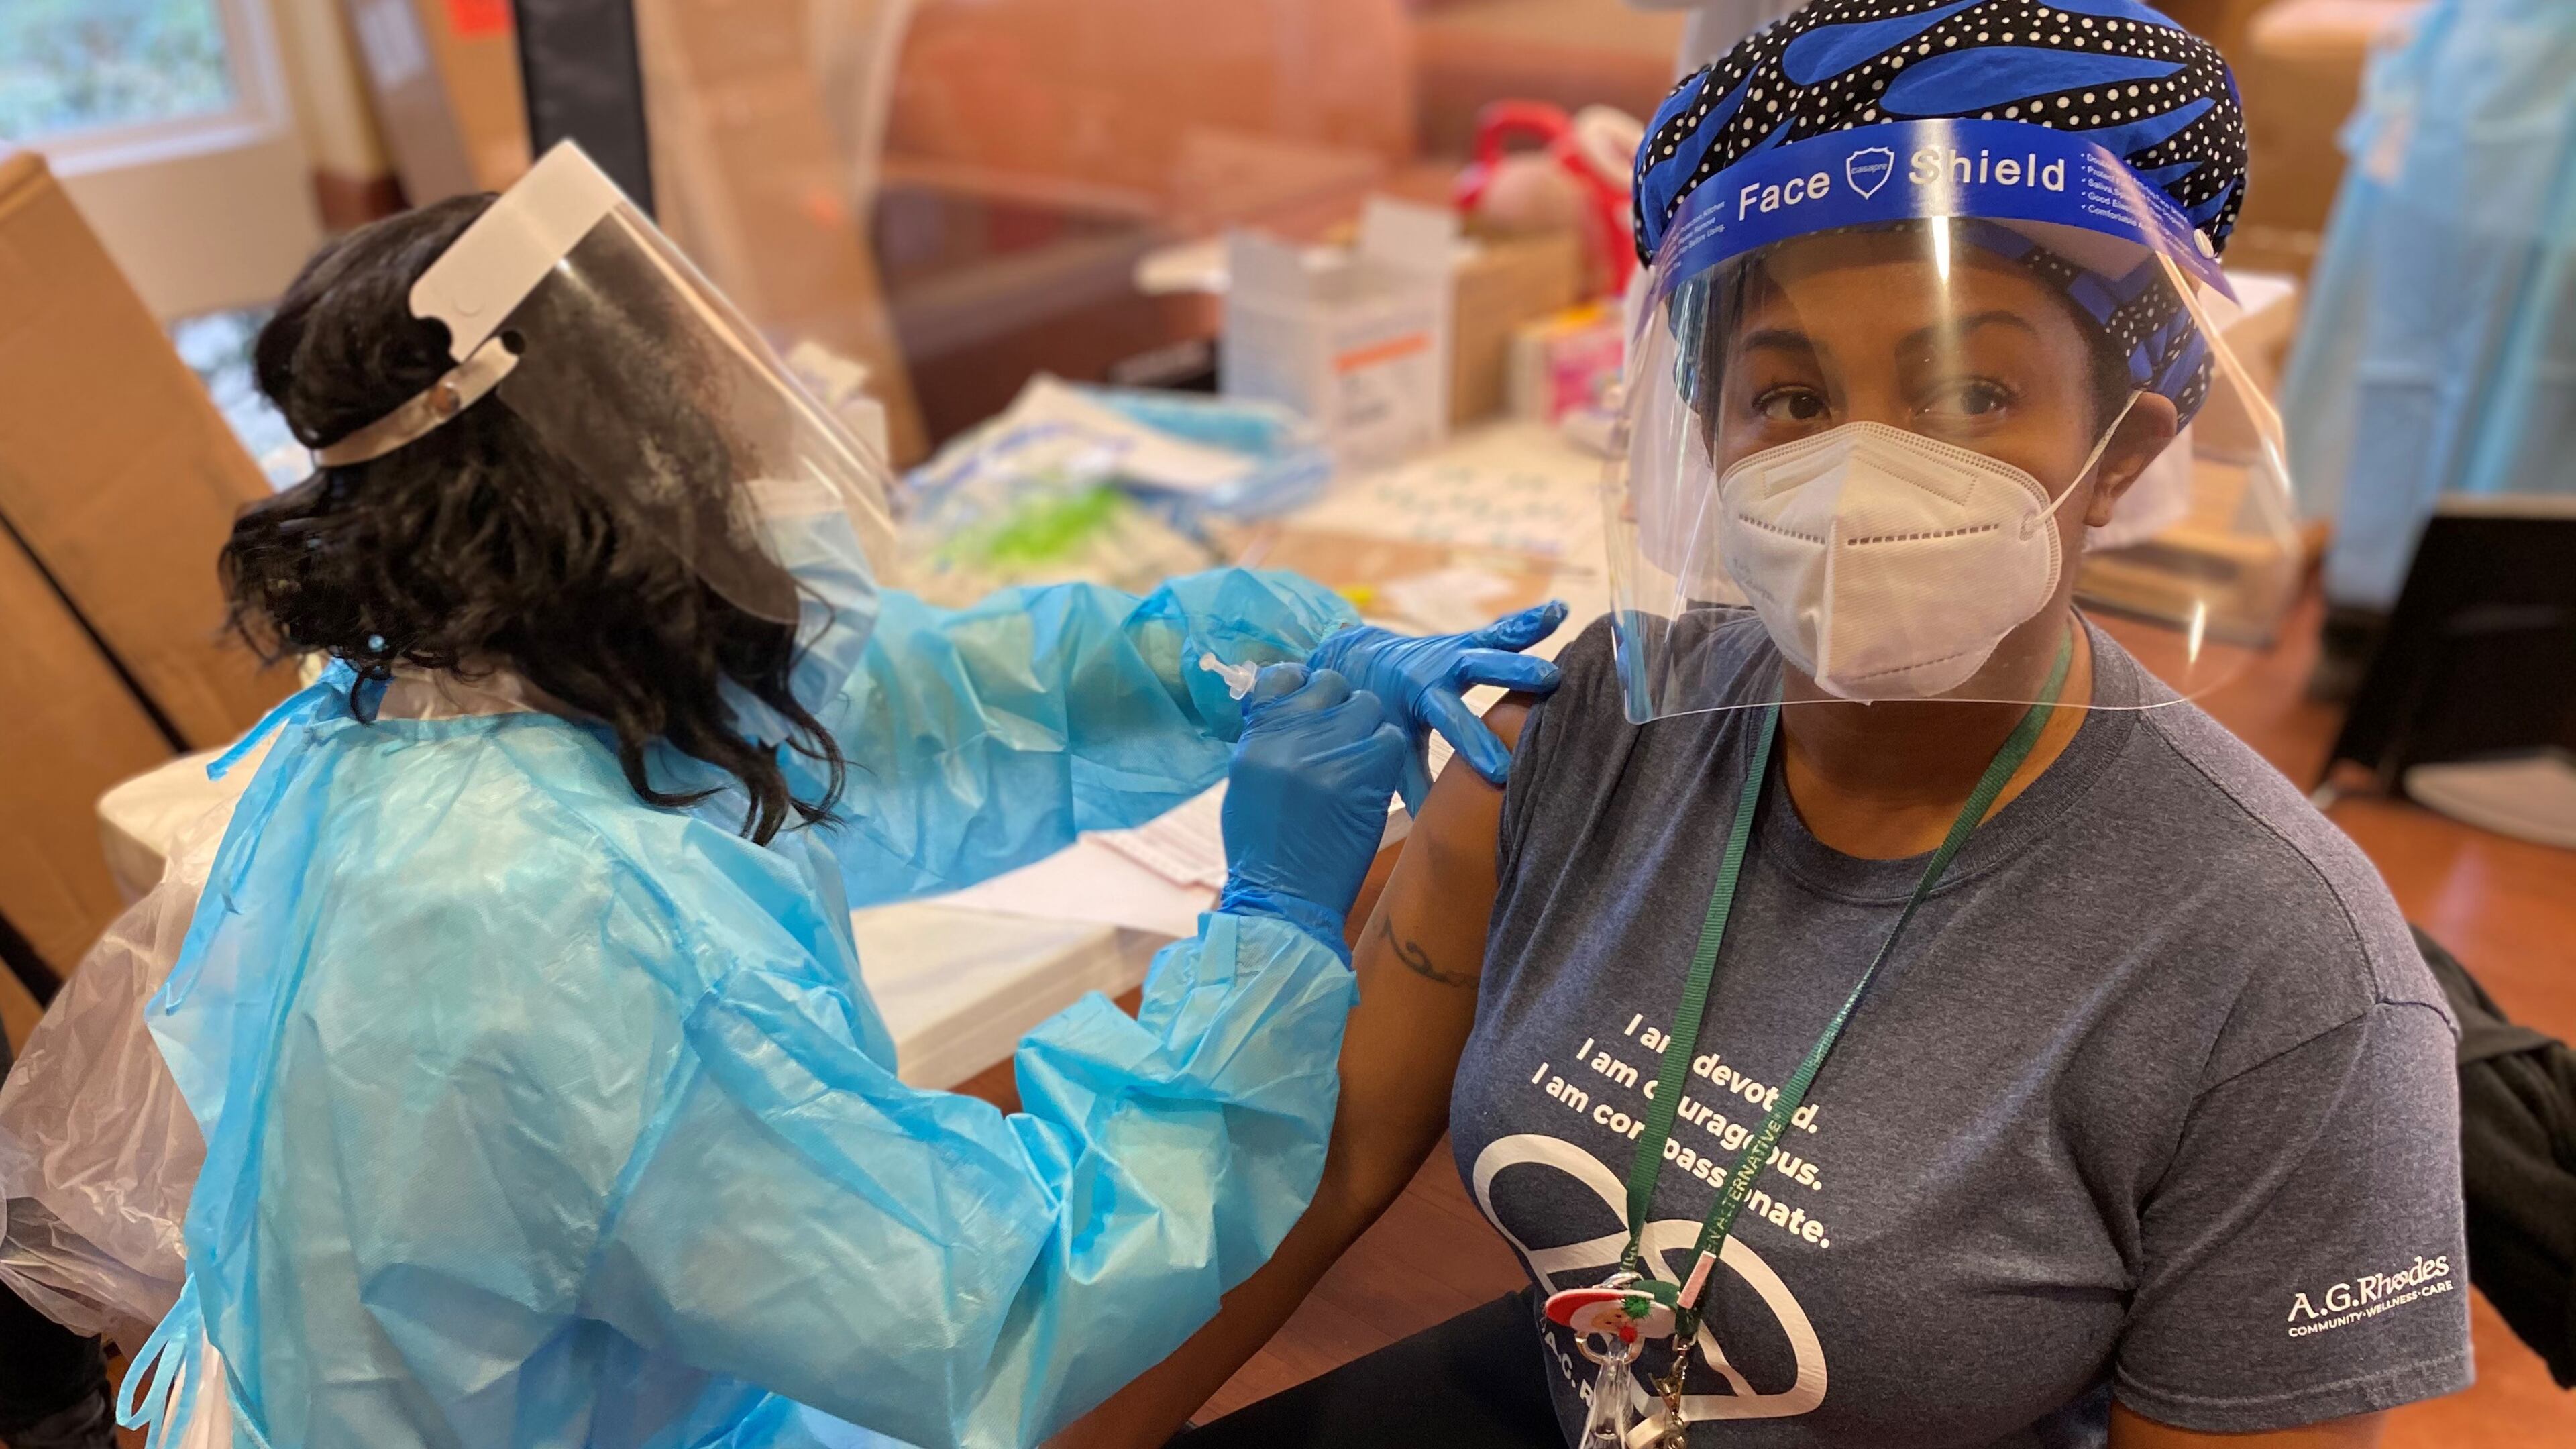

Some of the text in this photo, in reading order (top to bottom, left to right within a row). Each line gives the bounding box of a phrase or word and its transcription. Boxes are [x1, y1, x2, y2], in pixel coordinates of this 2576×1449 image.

[1739, 172, 1831, 221] Face
[1909, 148, 2065, 192] Shield
[1531, 1062, 1549, 1085] I
[1546, 1076, 1589, 1114] am
[1576, 1037, 1822, 1191] I am curagous.
[1624, 1013, 1644, 1036] I
[1693, 1053, 1819, 1134] devotd.
